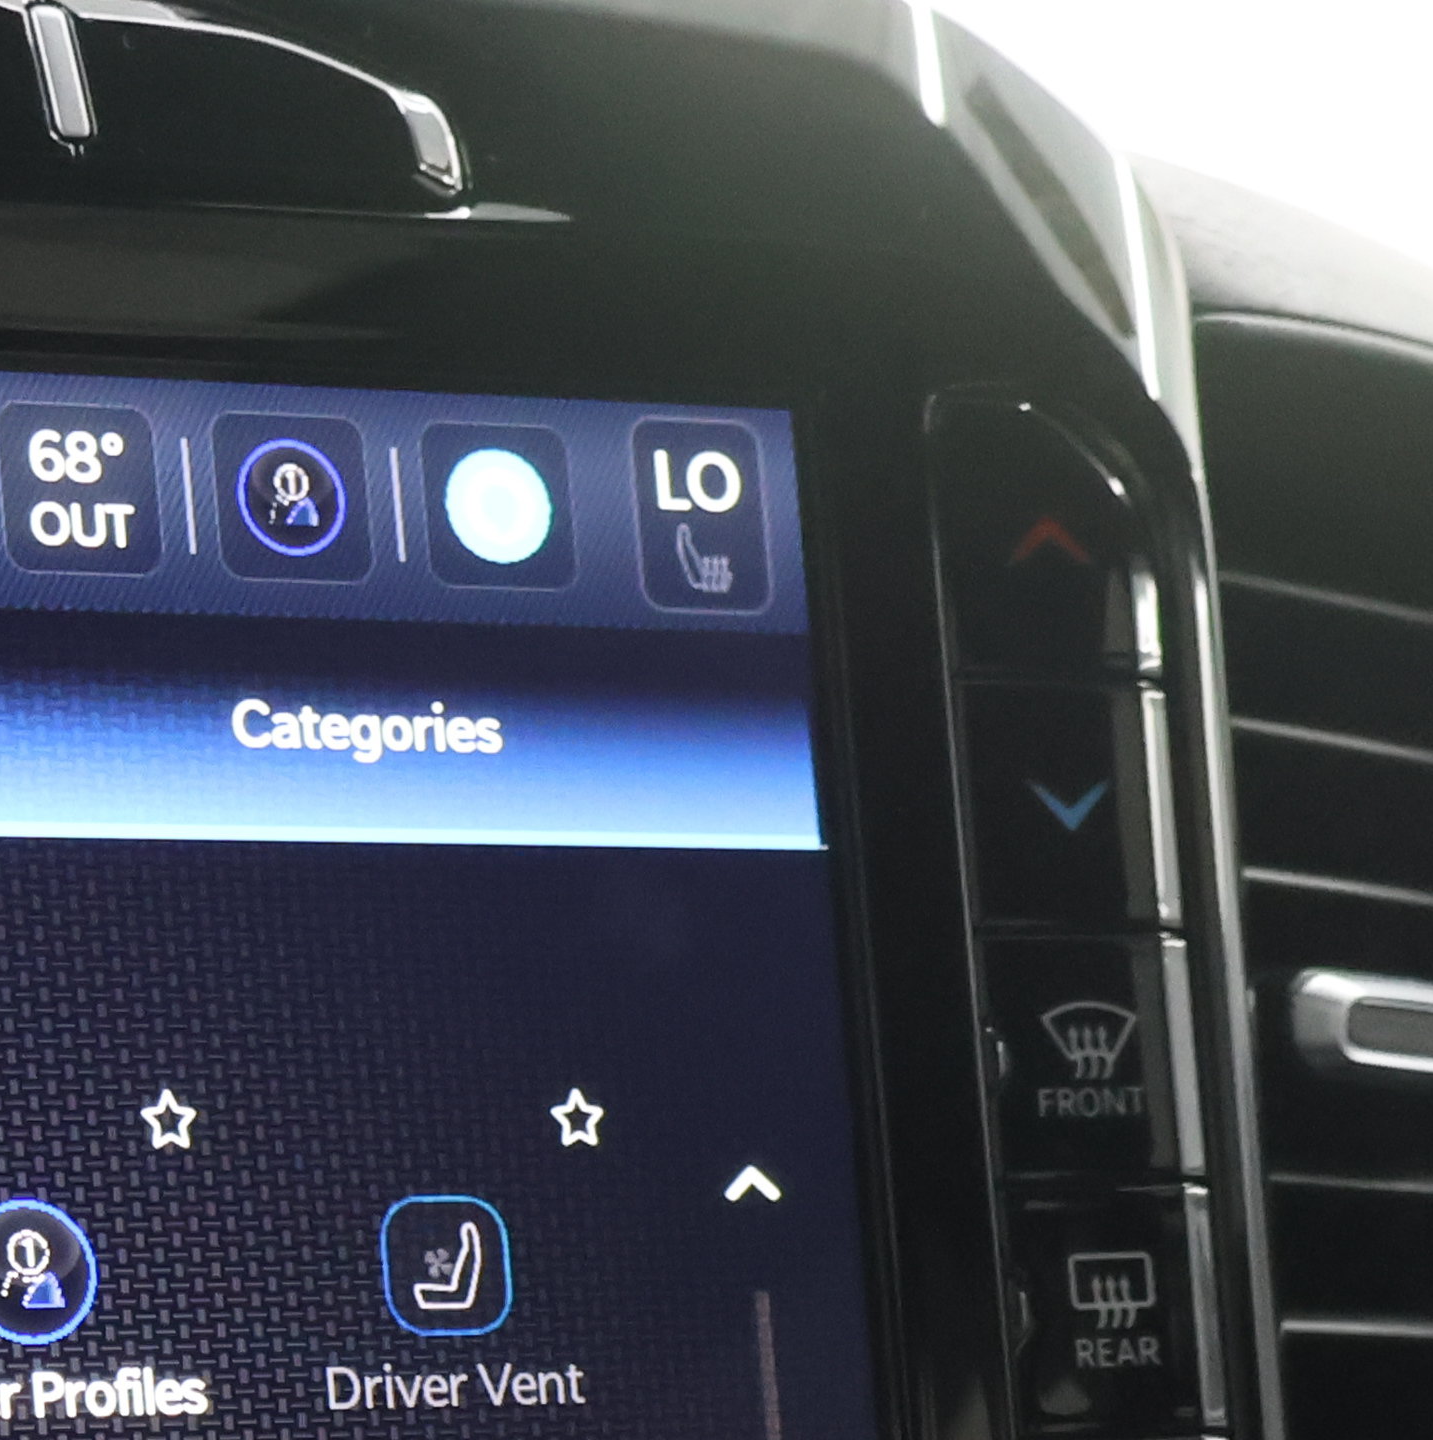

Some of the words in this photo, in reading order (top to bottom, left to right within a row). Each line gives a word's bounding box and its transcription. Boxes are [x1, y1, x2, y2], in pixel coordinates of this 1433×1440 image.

[28, 428, 124, 483] 68°
[654, 451, 740, 515] LO
[30, 500, 134, 549] OUT
[231, 699, 503, 763] Categories
[1039, 1087, 1144, 1119] FRONT
[1076, 1338, 1161, 1368] REAR
[32, 1367, 209, 1418] Profiles
[326, 1368, 467, 1410] Driver
[477, 1364, 585, 1407] Vent
